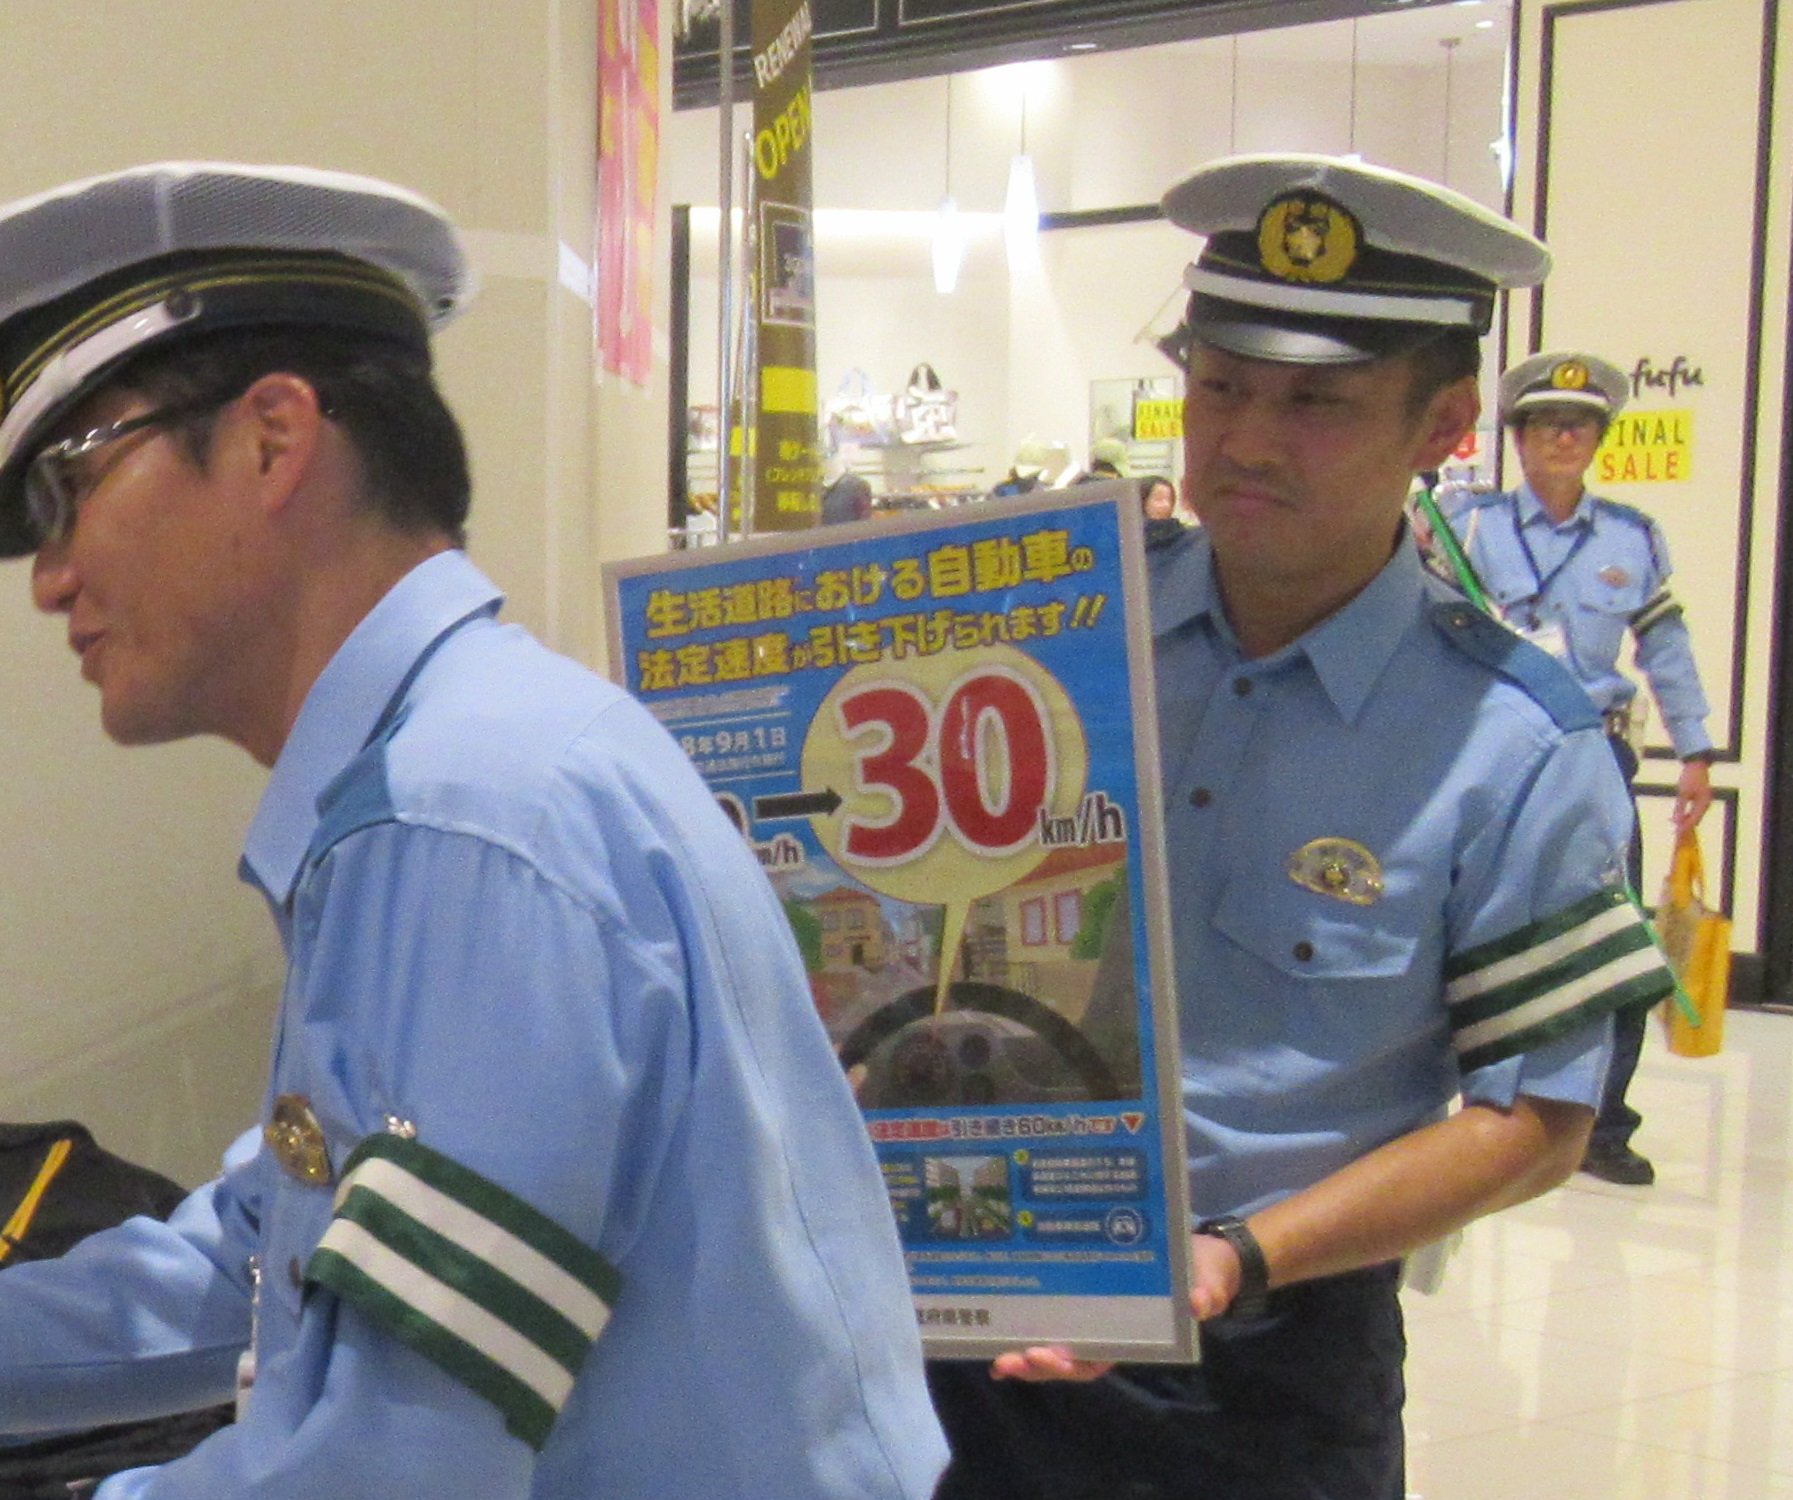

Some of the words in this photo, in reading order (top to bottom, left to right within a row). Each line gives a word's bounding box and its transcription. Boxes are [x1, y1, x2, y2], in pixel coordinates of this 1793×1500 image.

[1600, 450, 1680, 482] SALE
[1605, 416, 1686, 448] INAL
[645, 529, 1096, 639] 生活道路における自動車の
[838, 673, 1050, 861] 30
[1040, 793, 1125, 845] km/h
